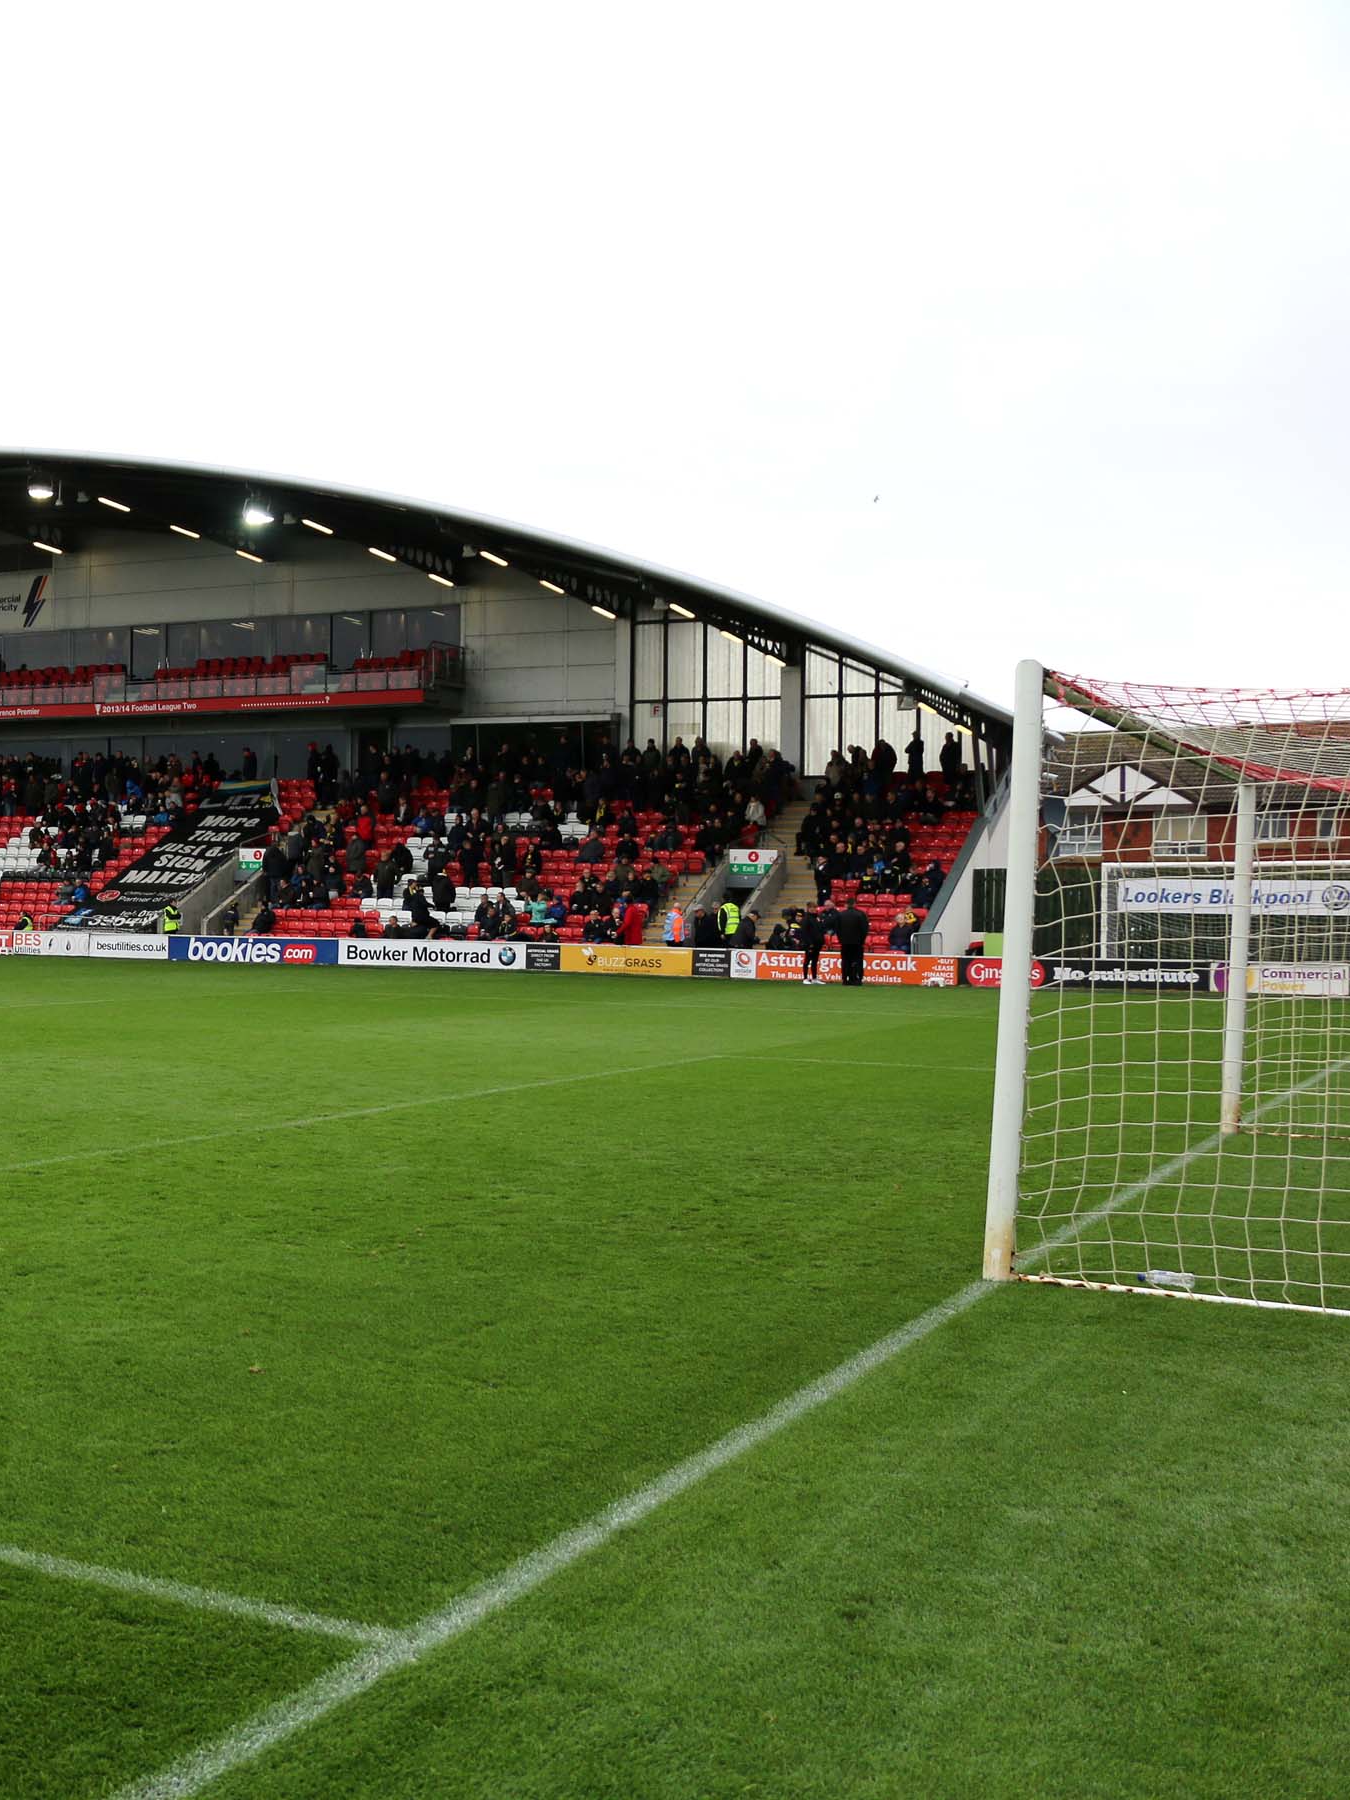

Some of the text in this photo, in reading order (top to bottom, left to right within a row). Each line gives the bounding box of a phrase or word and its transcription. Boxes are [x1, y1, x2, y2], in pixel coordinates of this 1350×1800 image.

[16, 707, 40, 716] Premier
[102, 702, 197, 713] 2013/14 Football League Two
[198, 815, 260, 828] More
[187, 830, 242, 842] Than
[152, 843, 206, 857] Just
[153, 853, 211, 872] SIGN
[1122, 887, 1313, 909] Lookers Blakpool
[14, 932, 41, 946] BES
[14, 946, 41, 955] Utilities
[96, 940, 167, 952] besutilities.co.uk
[187, 937, 281, 963] bookies
[346, 944, 491, 964] Bowker Motorrad
[770, 970, 785, 978] The
[1053, 966, 1200, 984] No substitute
[1262, 968, 1346, 980] Commercial
[1262, 981, 1306, 991] Power
